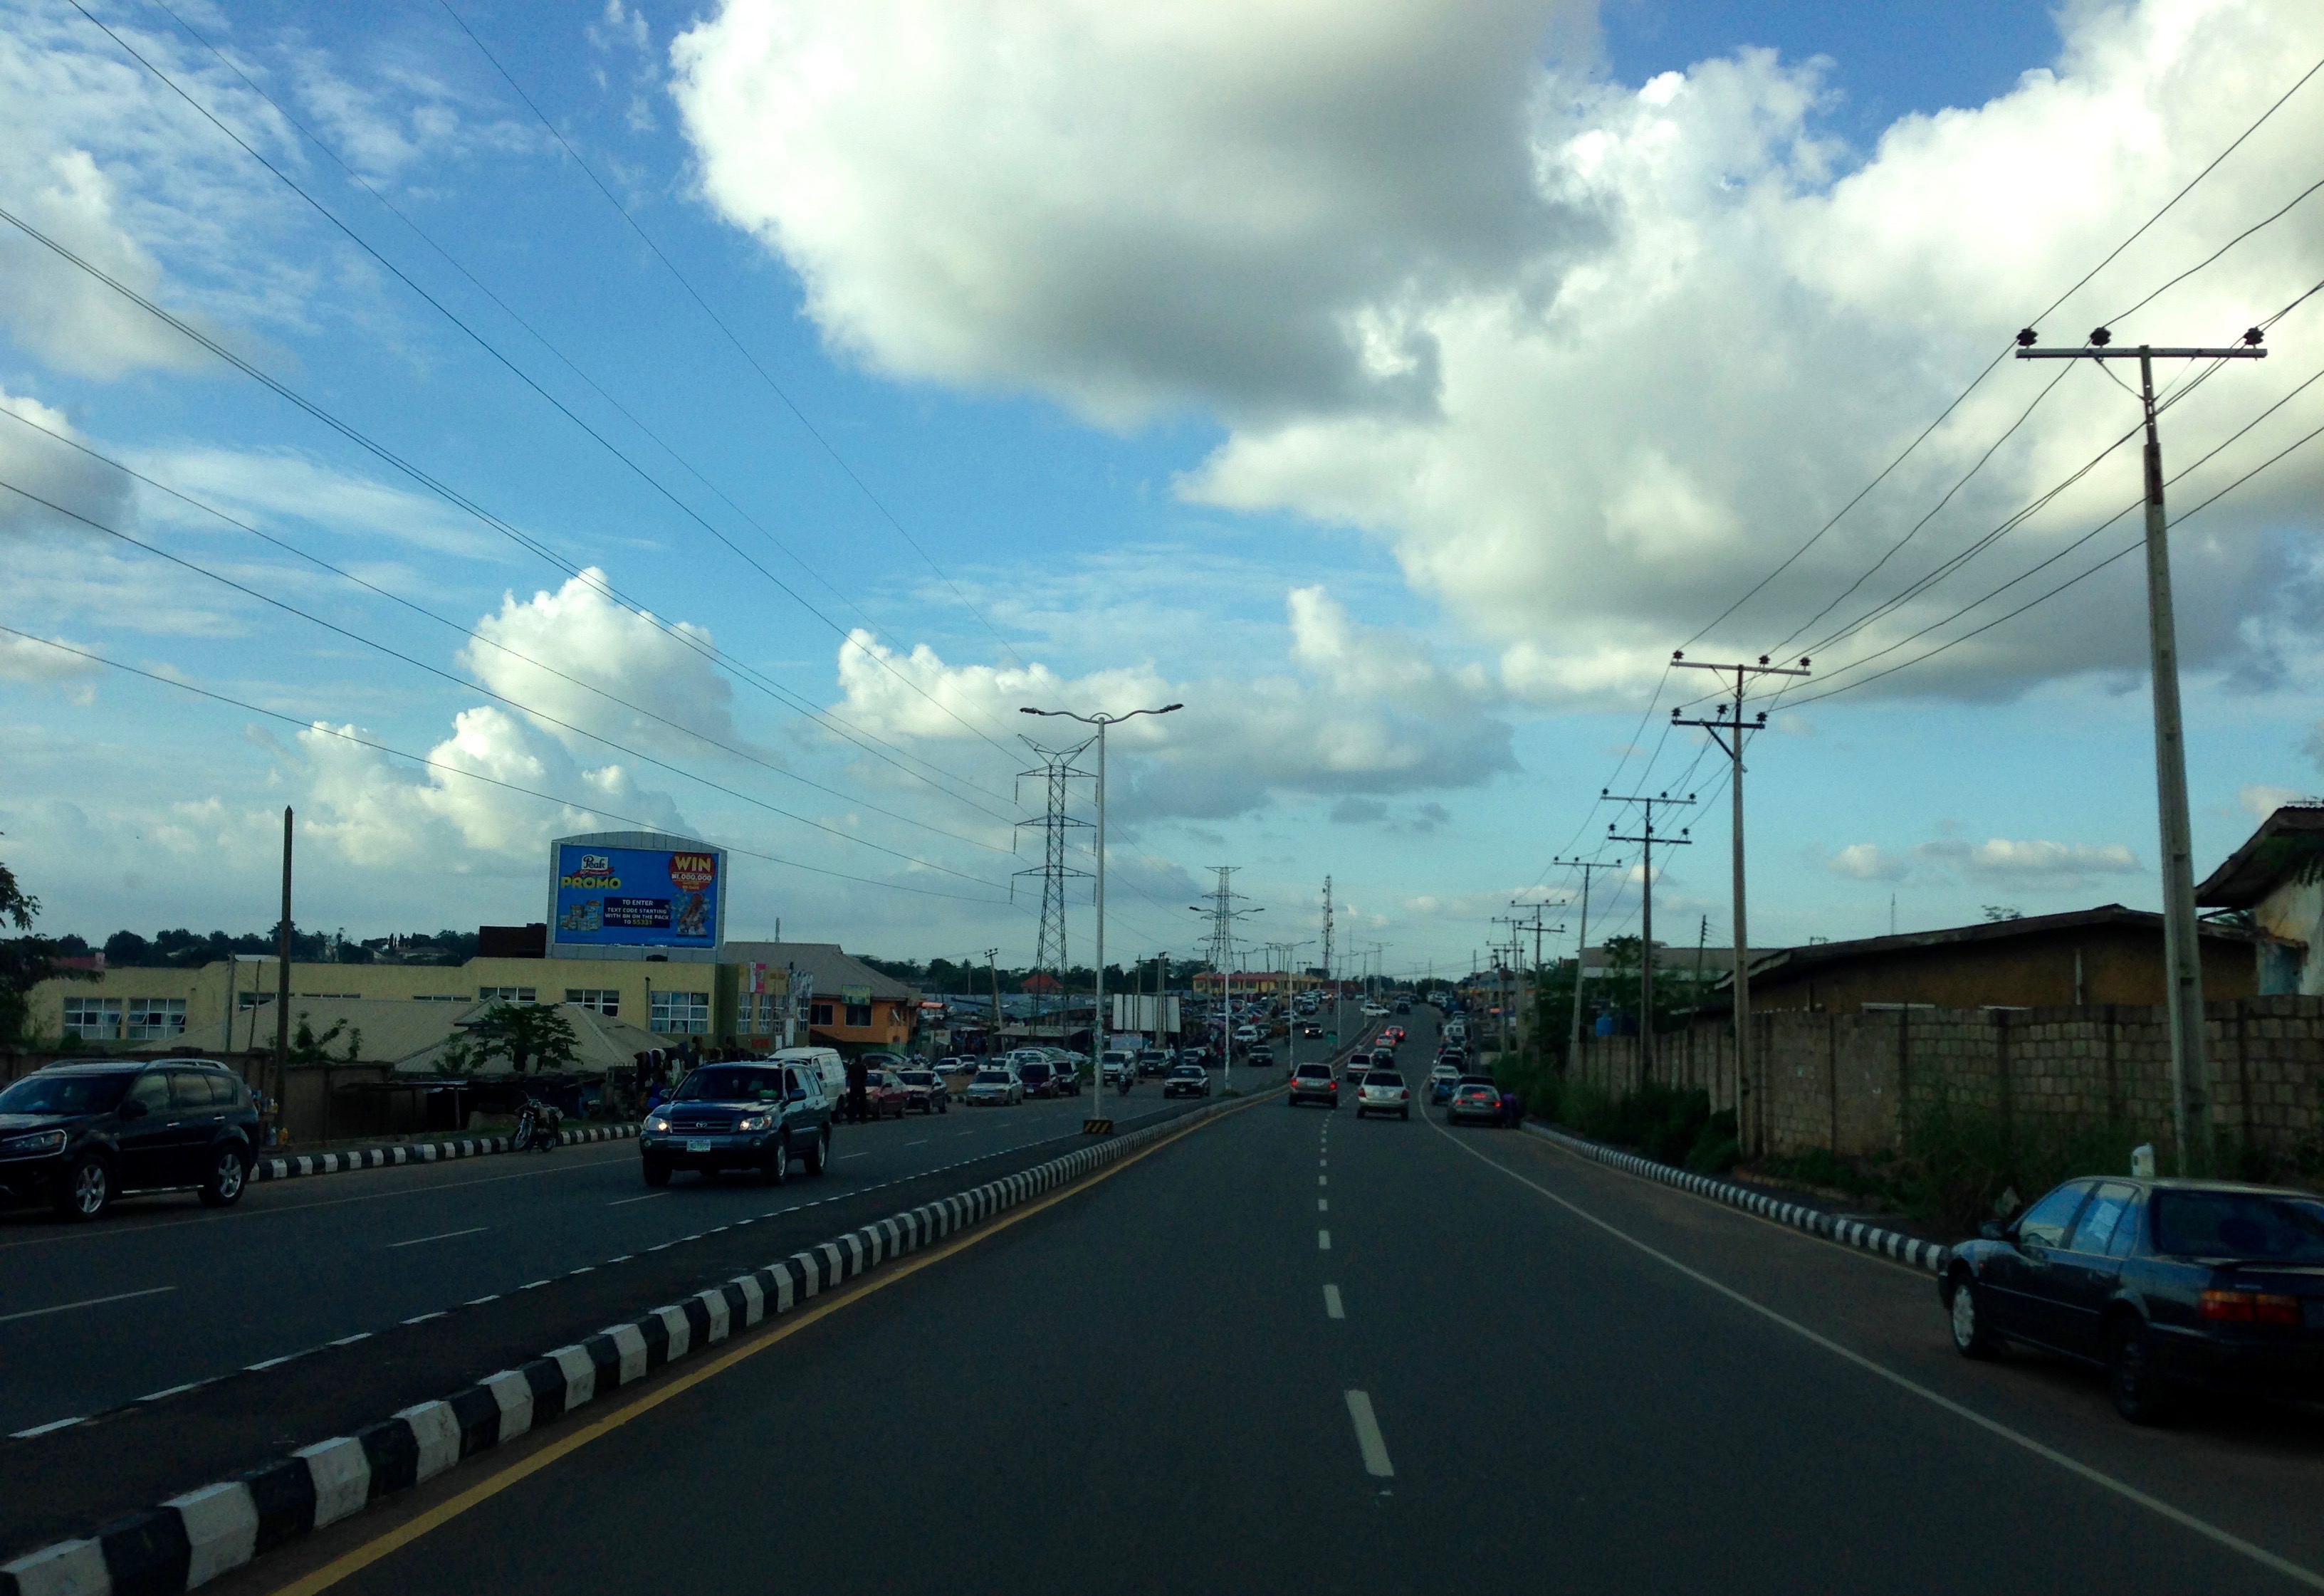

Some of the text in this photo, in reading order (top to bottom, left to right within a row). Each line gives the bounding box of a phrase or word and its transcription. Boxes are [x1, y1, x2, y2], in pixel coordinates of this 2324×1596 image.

[583, 855, 605, 868] Peak
[674, 856, 711, 872] WIN
[560, 876, 622, 889] PROMO
